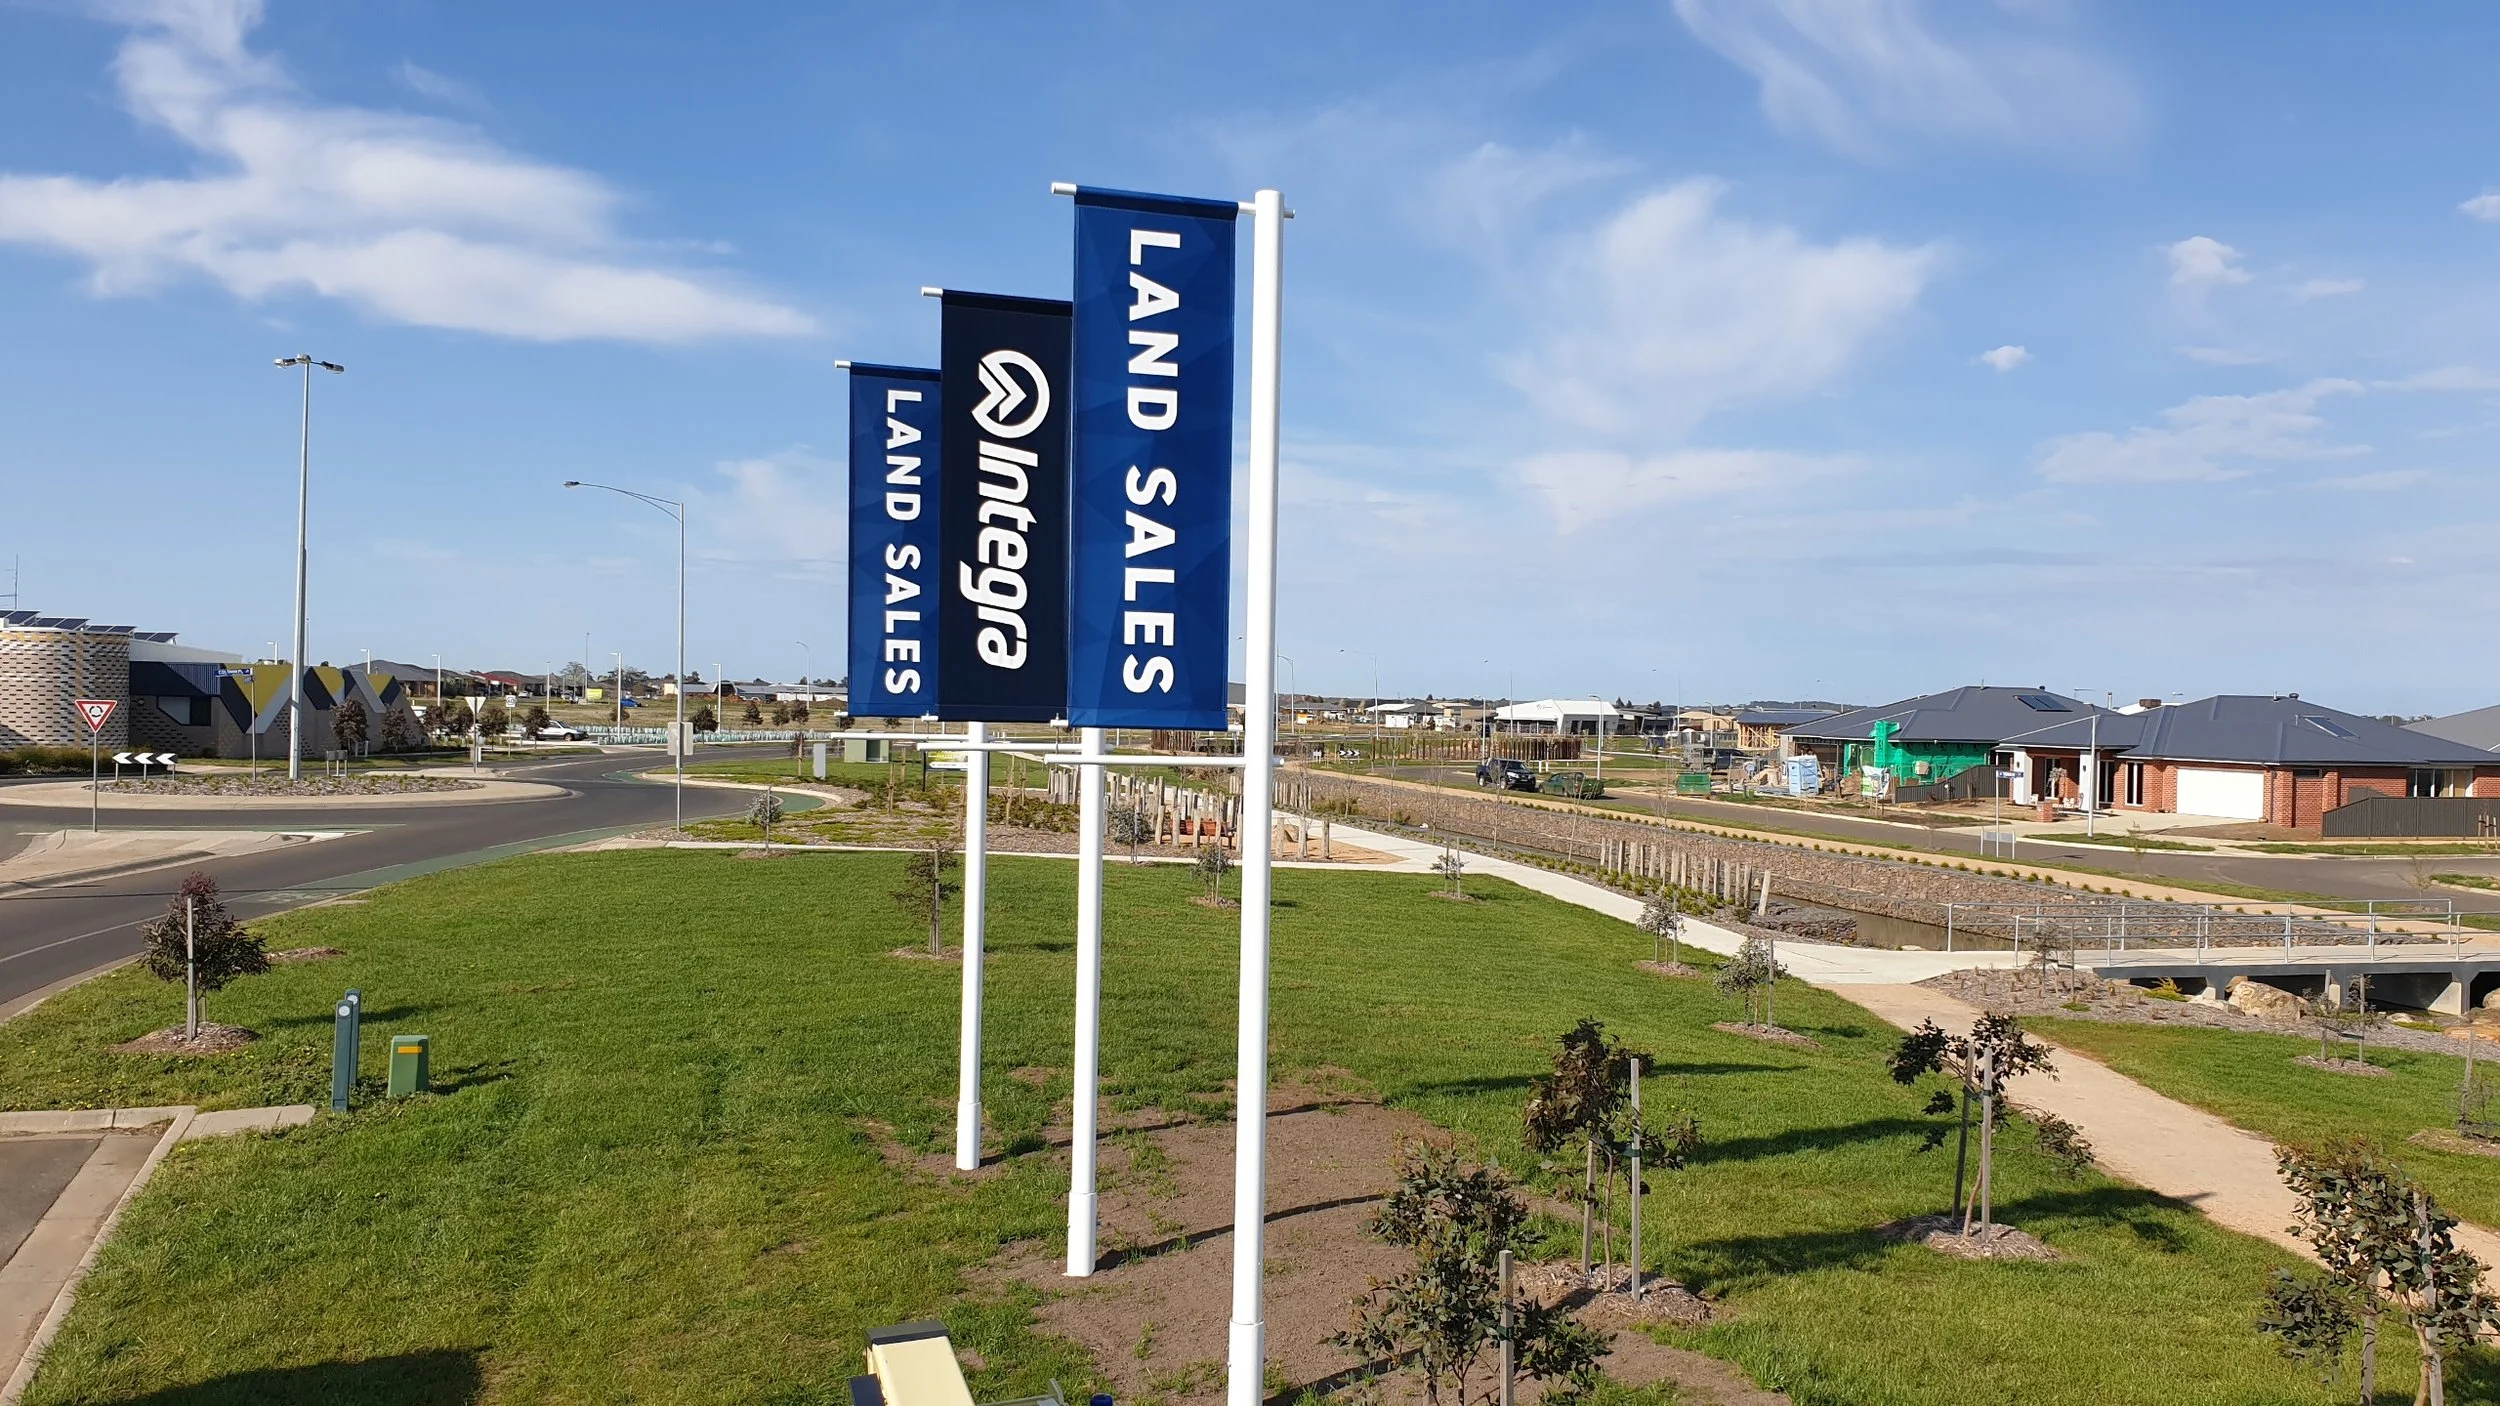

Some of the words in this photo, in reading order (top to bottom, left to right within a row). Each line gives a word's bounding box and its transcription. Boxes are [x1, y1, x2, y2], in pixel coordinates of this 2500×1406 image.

[1127, 229, 1181, 431] LAND
[885, 389, 923, 521] LAND
[959, 440, 1039, 670] Integra
[884, 543, 921, 694] SALES
[1122, 464, 1177, 694] SALES
